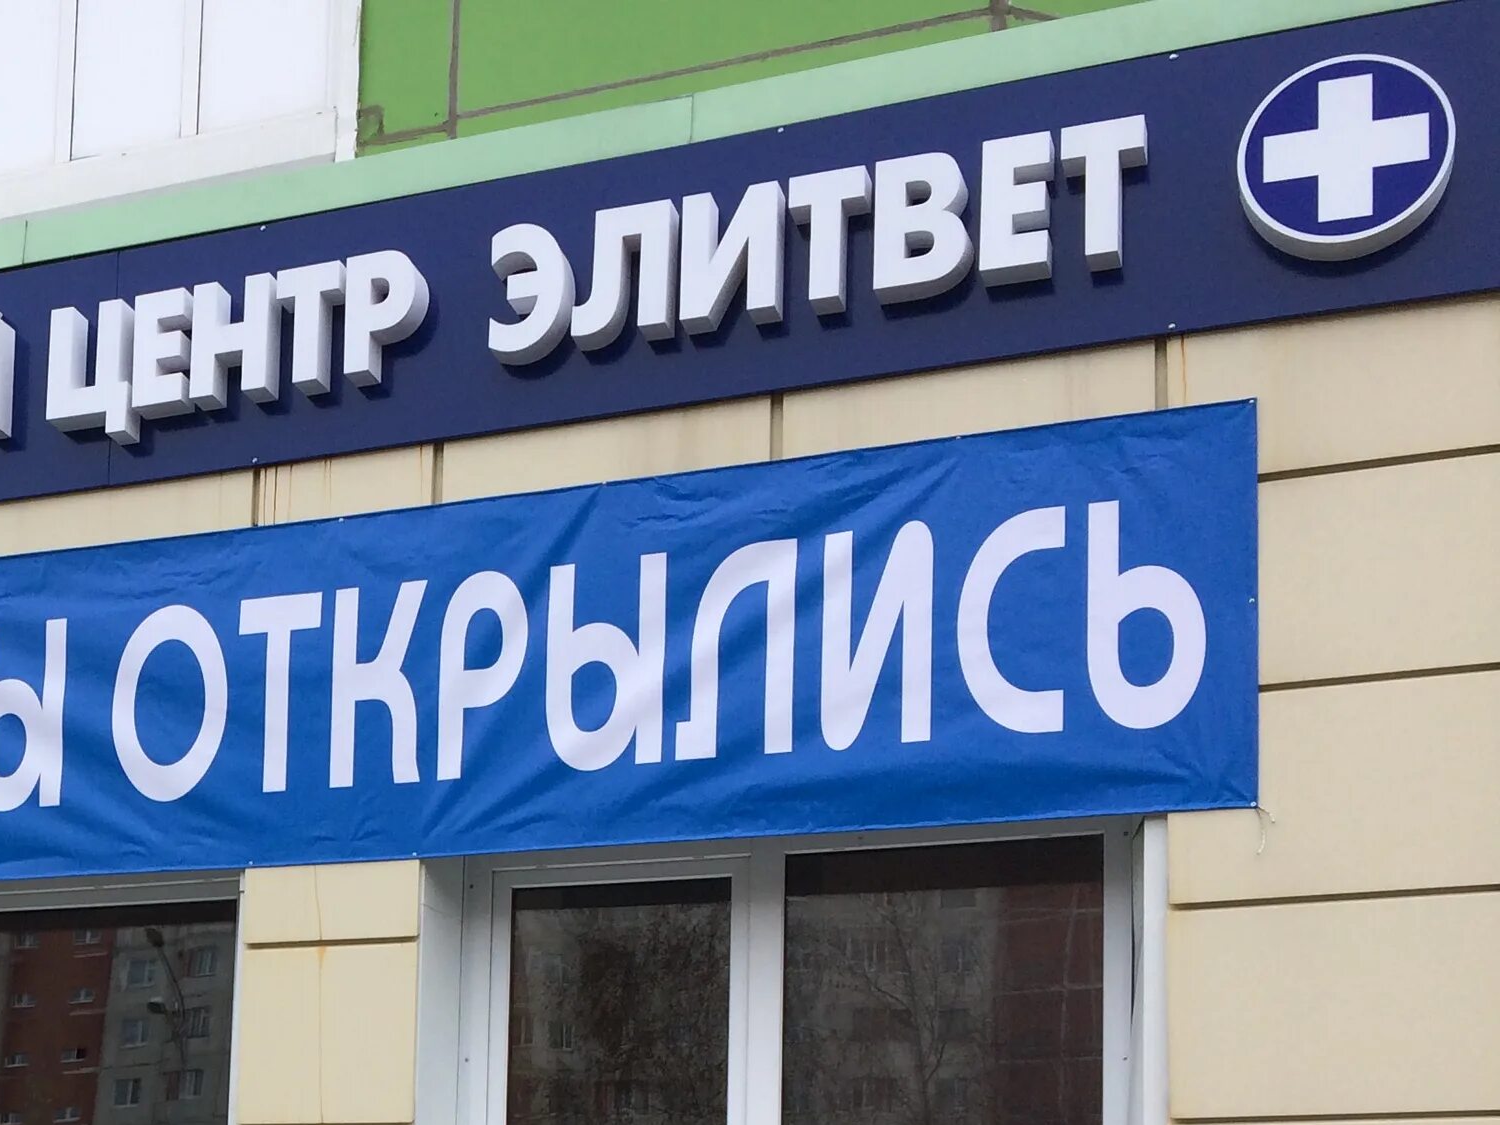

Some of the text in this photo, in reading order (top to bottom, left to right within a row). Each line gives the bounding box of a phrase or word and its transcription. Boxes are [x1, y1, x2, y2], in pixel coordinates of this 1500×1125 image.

[45, 248, 430, 445] ЦЕНТР
[486, 114, 1148, 366] ЭЛИТВЕТ
[111, 499, 1207, 802] ОТКРЫЛИСЬ
